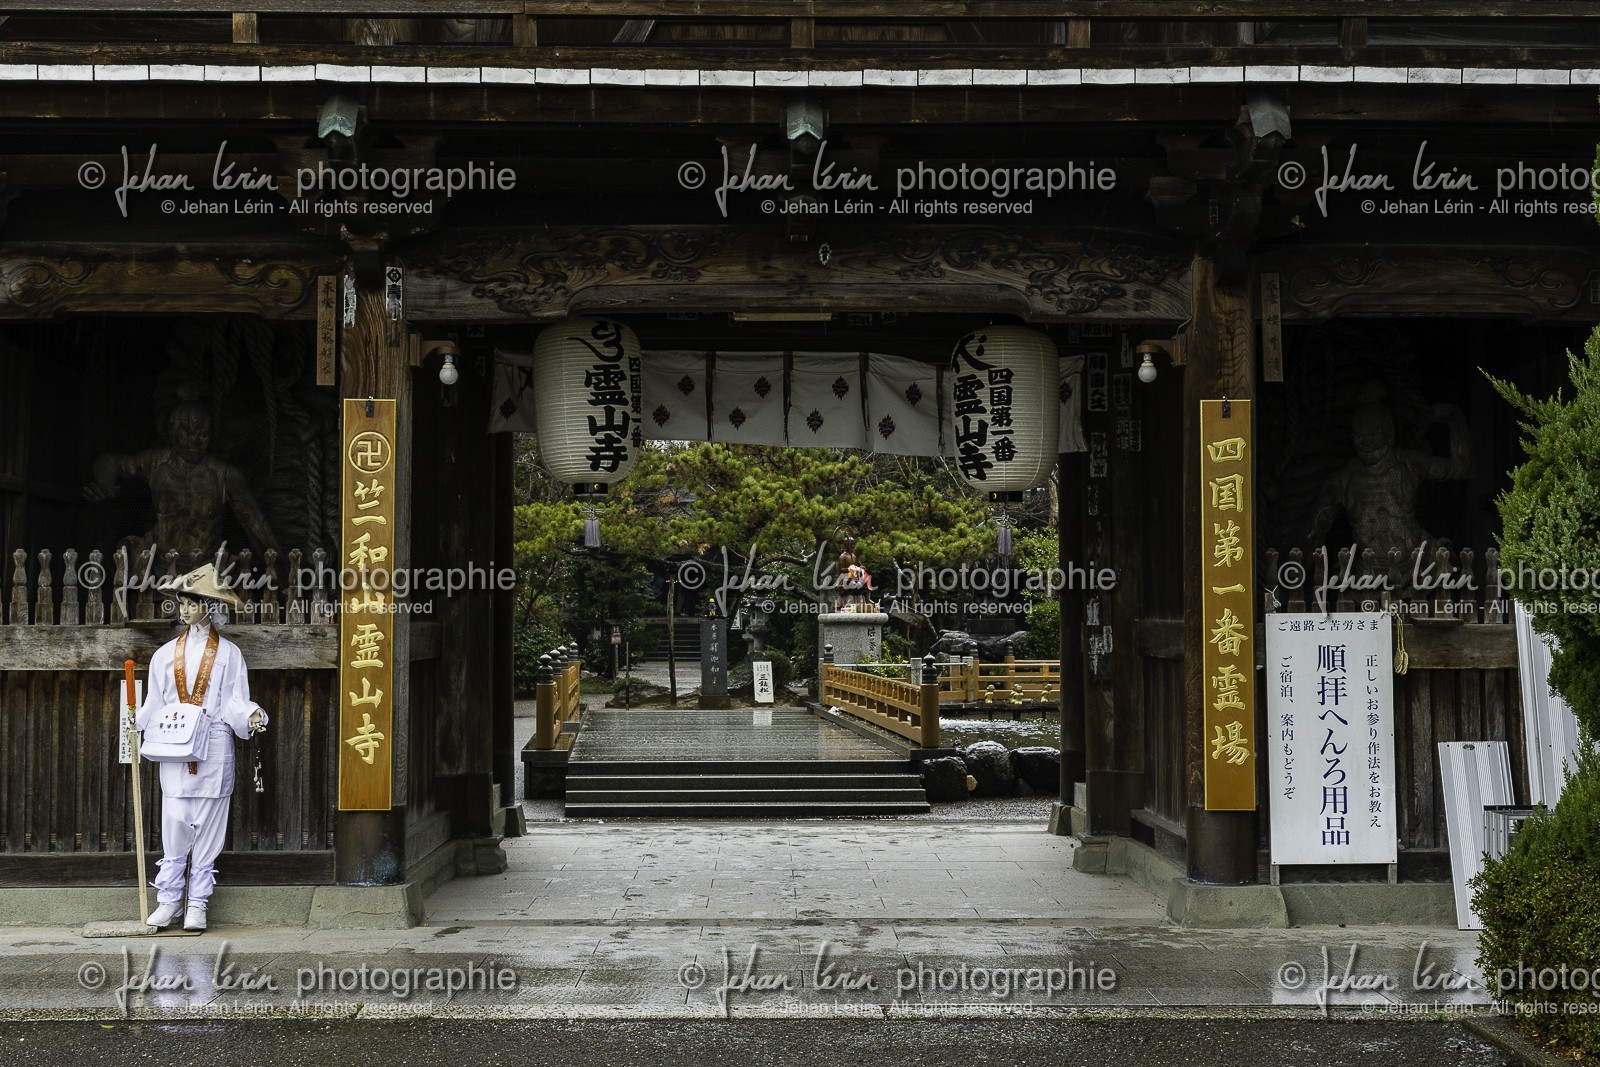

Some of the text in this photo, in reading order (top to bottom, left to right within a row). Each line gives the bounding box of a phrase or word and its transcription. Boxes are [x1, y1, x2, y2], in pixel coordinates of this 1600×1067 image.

[583, 364, 630, 473] 霊山寺
[953, 374, 994, 481] 霊山寺
[988, 367, 1018, 462] 四国第一番
[1206, 437, 1250, 766] 四国第一番霊場
[1278, 620, 1379, 632] ご遠路ご苦労さま
[1280, 656, 1296, 800] ご宿泊、案内もどうぞ
[1316, 644, 1351, 846] 順拝へんろ用品
[1365, 654, 1382, 828] 正しいお参り作法をお教え
